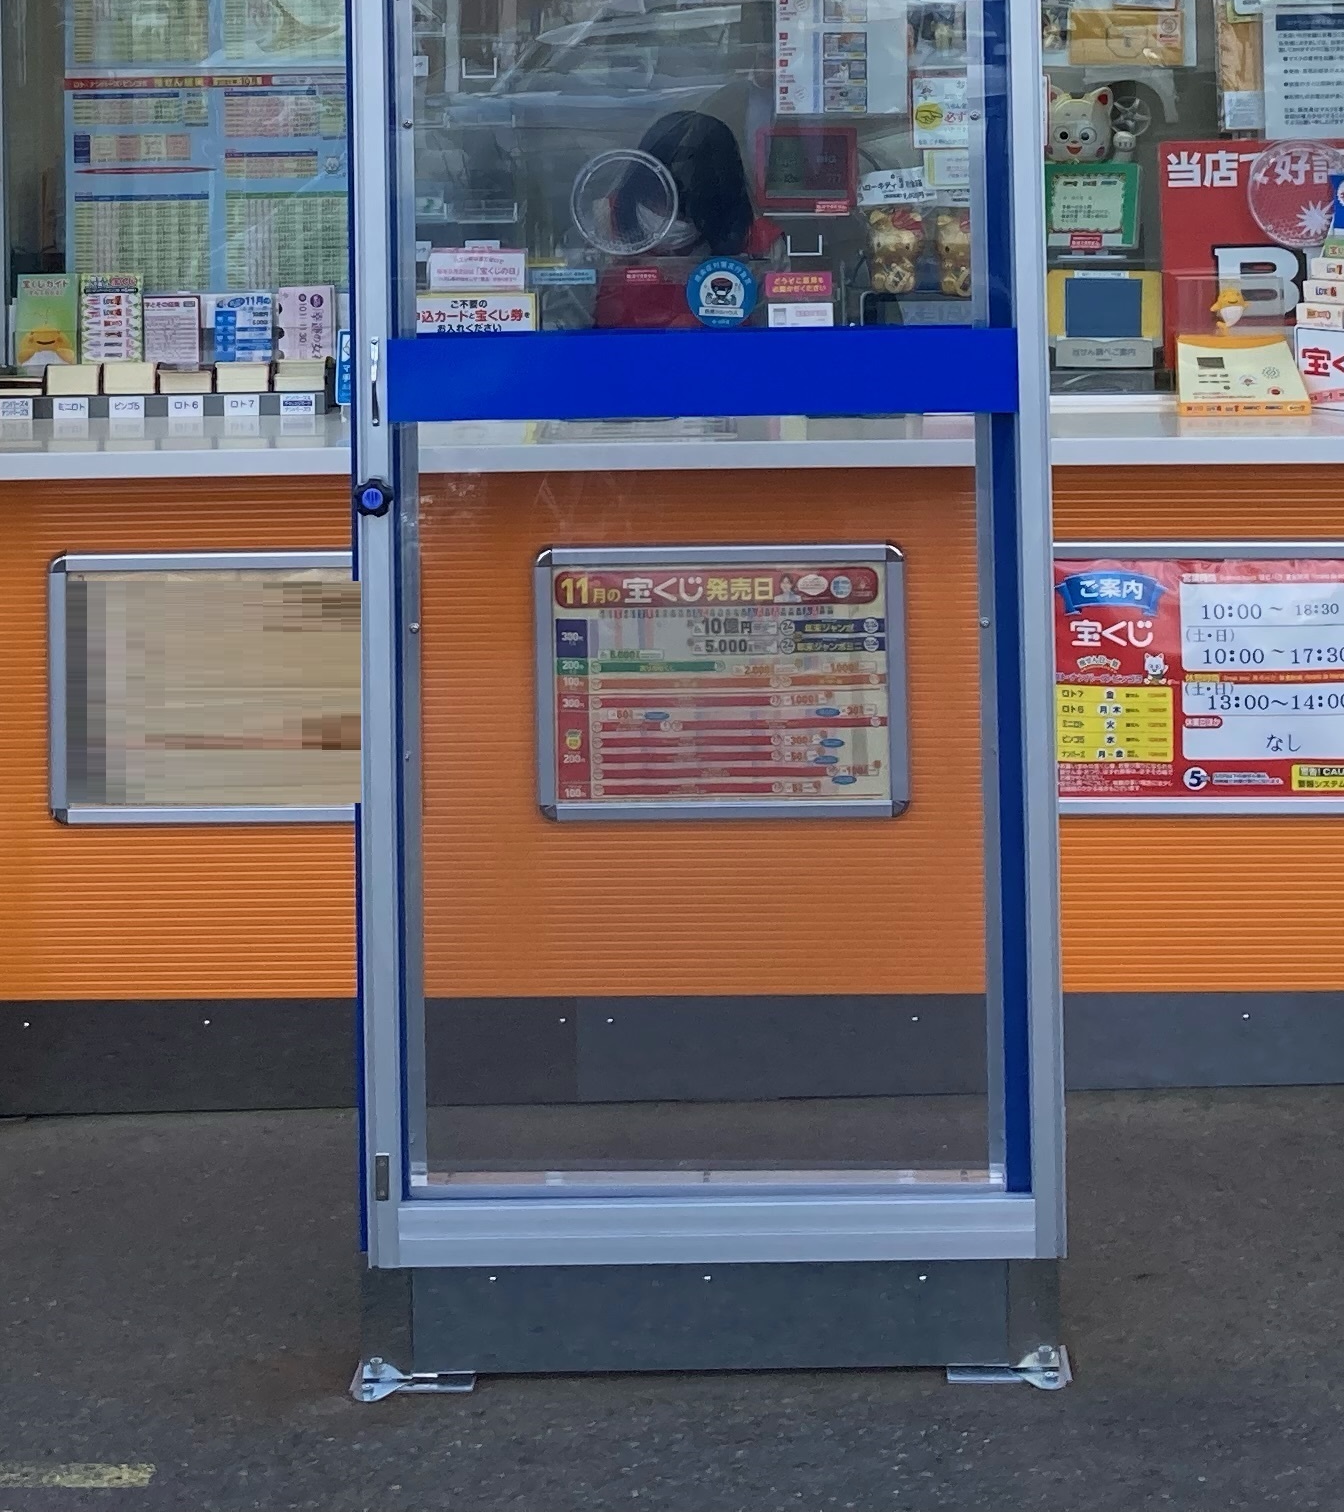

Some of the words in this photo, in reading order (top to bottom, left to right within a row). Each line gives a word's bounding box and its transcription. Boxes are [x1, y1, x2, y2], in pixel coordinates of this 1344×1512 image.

[58, 403, 86, 411] ミニロト
[114, 403, 140, 411] ビンゴ5
[1079, 579, 1144, 599] ご案内
[1070, 619, 1154, 648] 宝くじ
[1266, 733, 1302, 753] なし
